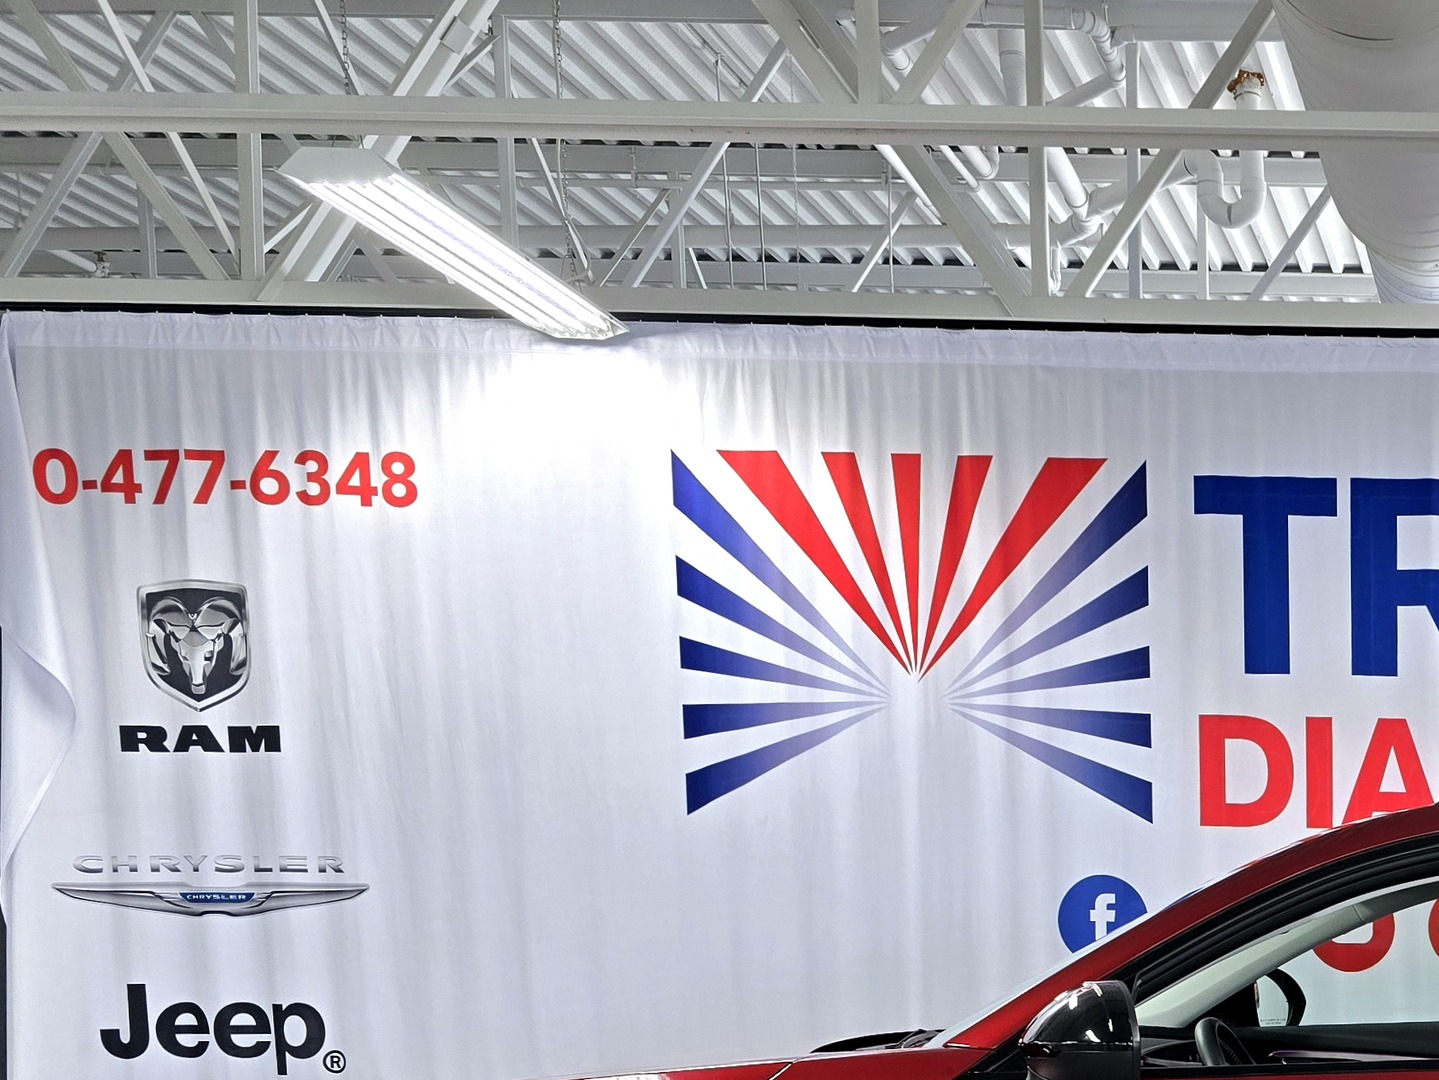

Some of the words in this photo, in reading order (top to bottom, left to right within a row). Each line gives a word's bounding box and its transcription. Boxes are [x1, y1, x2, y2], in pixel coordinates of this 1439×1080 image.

[33, 449, 418, 508] 0-477-6348
[119, 725, 281, 753] RAM
[73, 855, 345, 874] CHRYSLER
[186, 893, 247, 901] CHRYSLER
